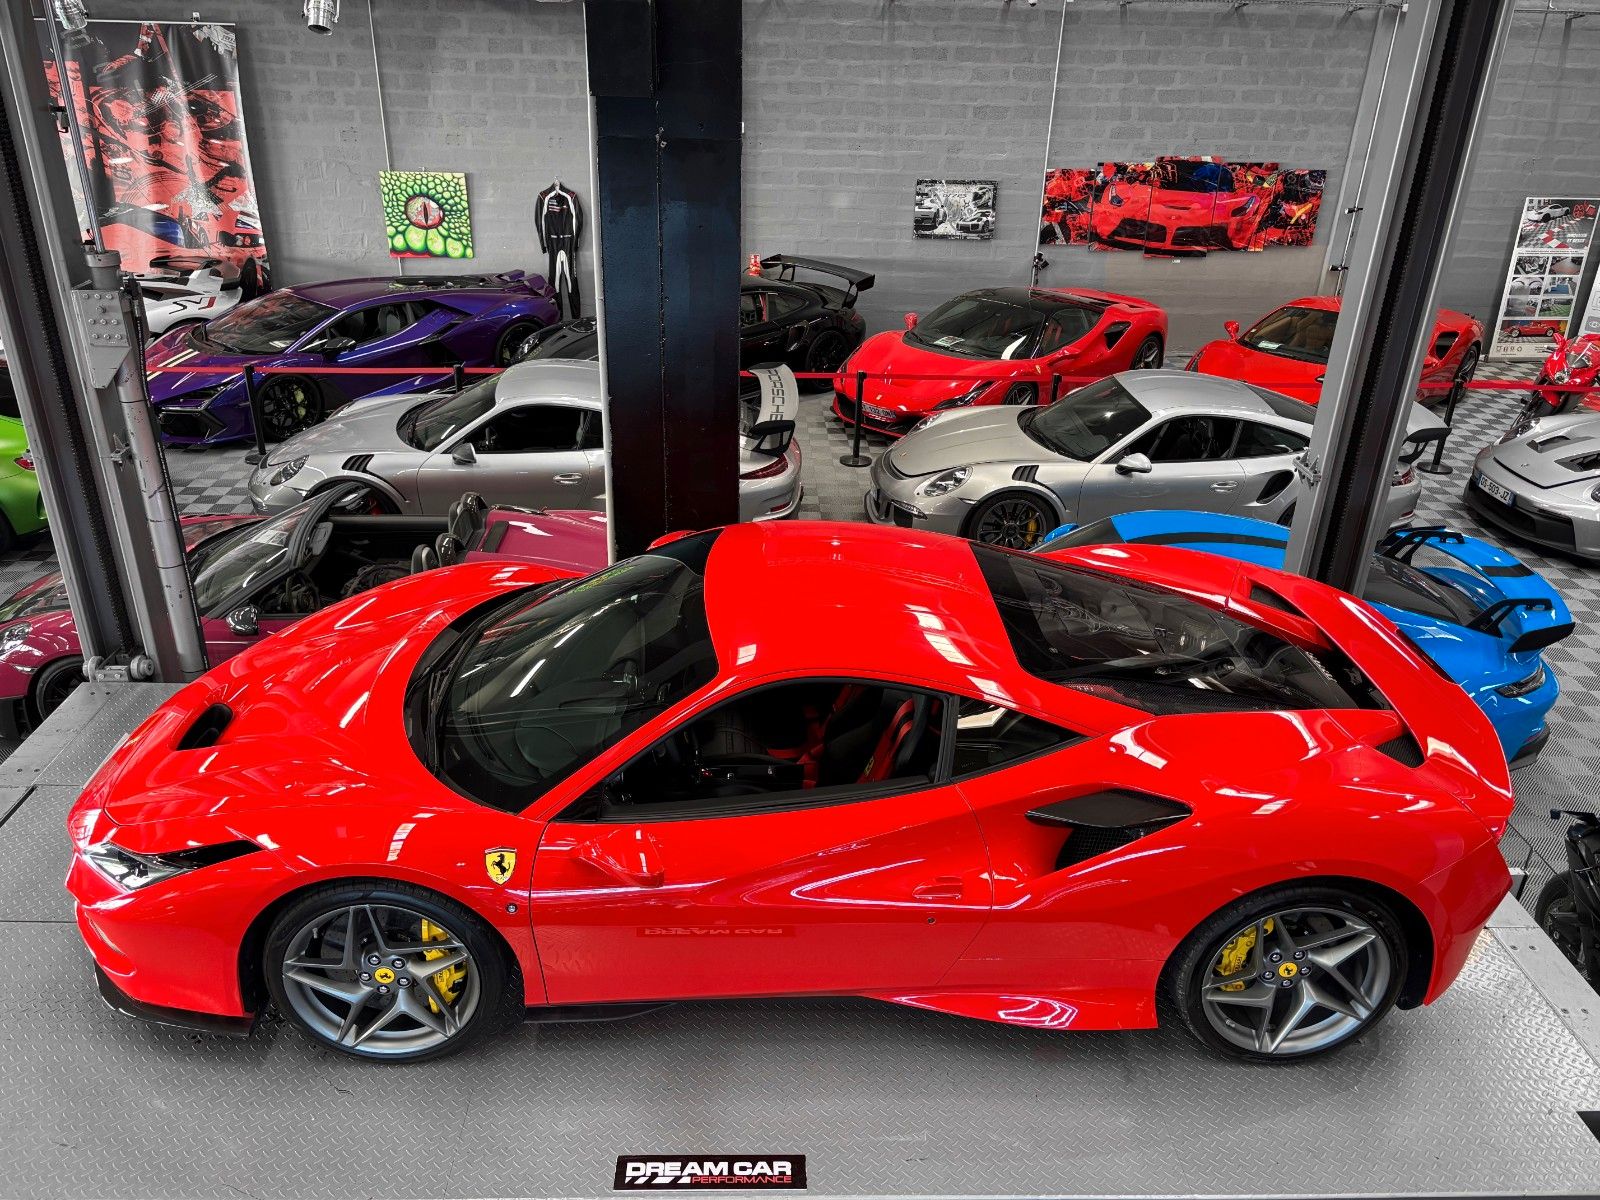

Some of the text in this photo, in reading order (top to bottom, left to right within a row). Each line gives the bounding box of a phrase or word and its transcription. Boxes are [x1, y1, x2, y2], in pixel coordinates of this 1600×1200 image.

[767, 368, 785, 421] PORSCHE
[625, 1161, 792, 1177] DREAM CAR
[691, 1176, 793, 1184] PERFORMANCE
